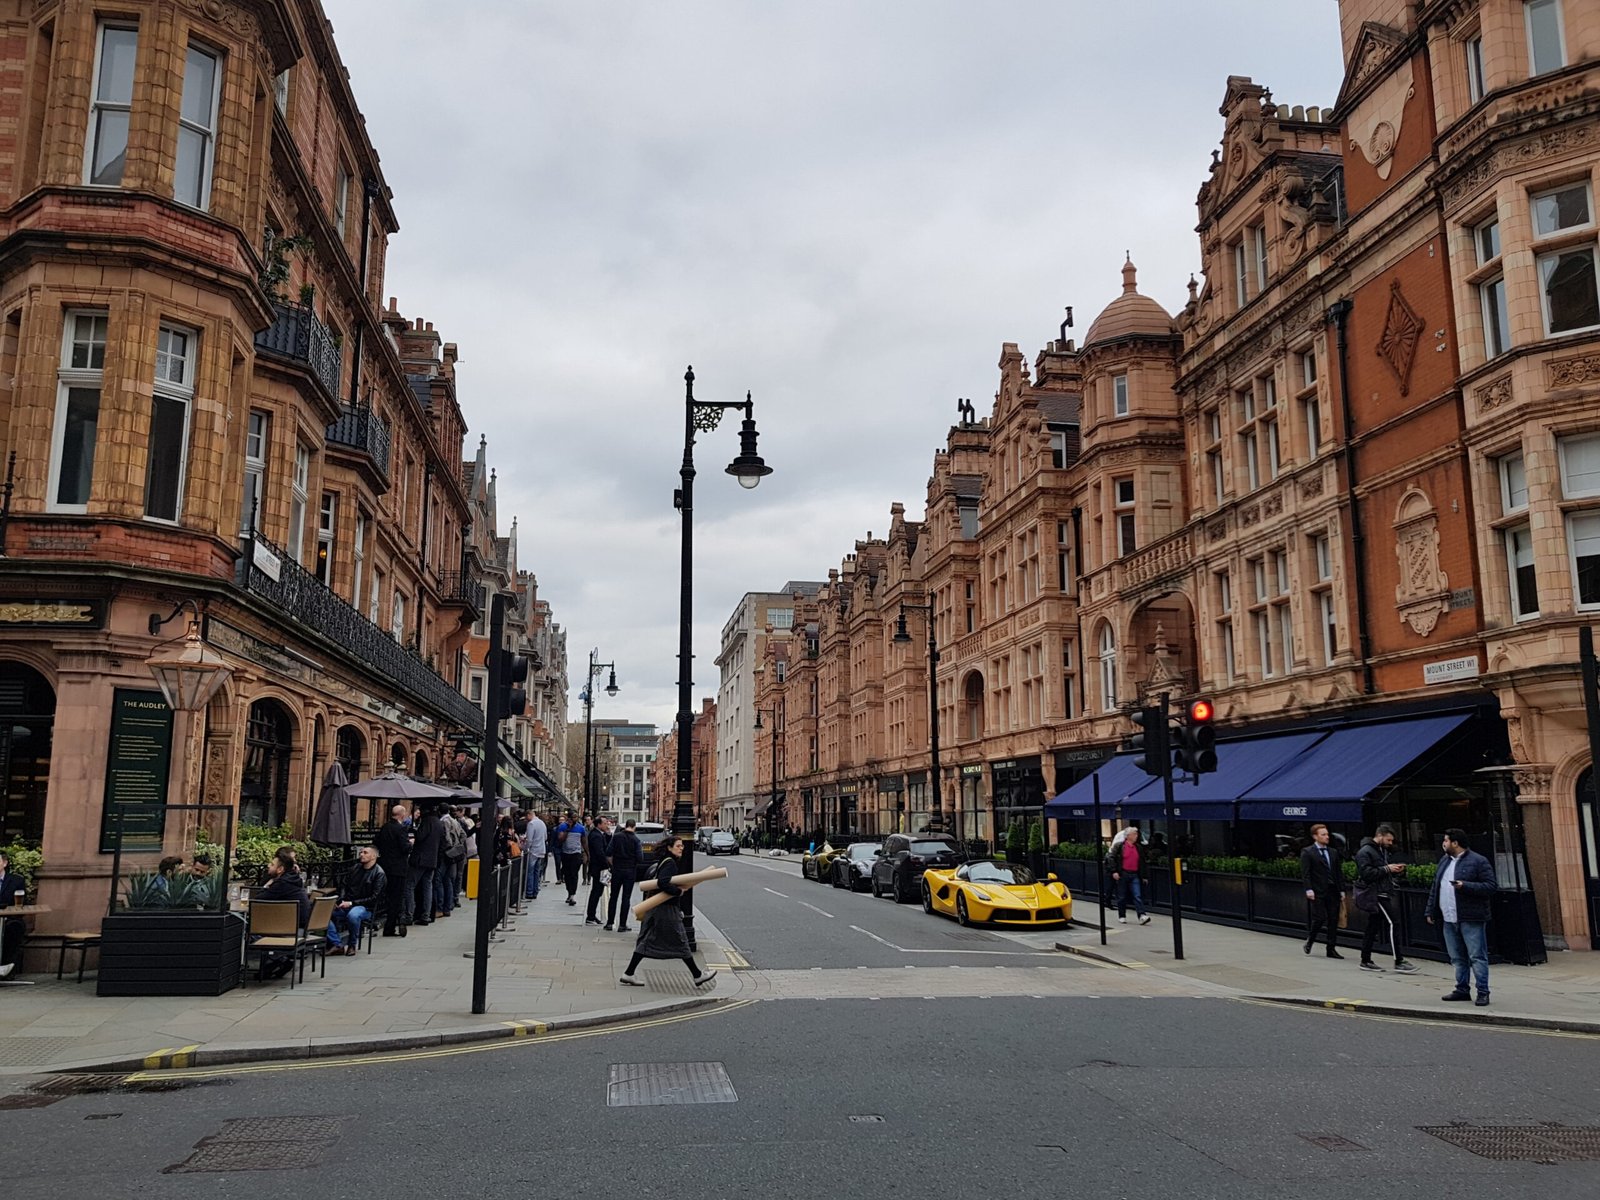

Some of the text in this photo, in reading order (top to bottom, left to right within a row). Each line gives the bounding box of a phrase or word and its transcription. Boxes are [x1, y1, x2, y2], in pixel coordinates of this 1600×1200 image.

[1426, 659, 1475, 674] MOUNT STREET W1
[1283, 806, 1308, 816] GEORGE
